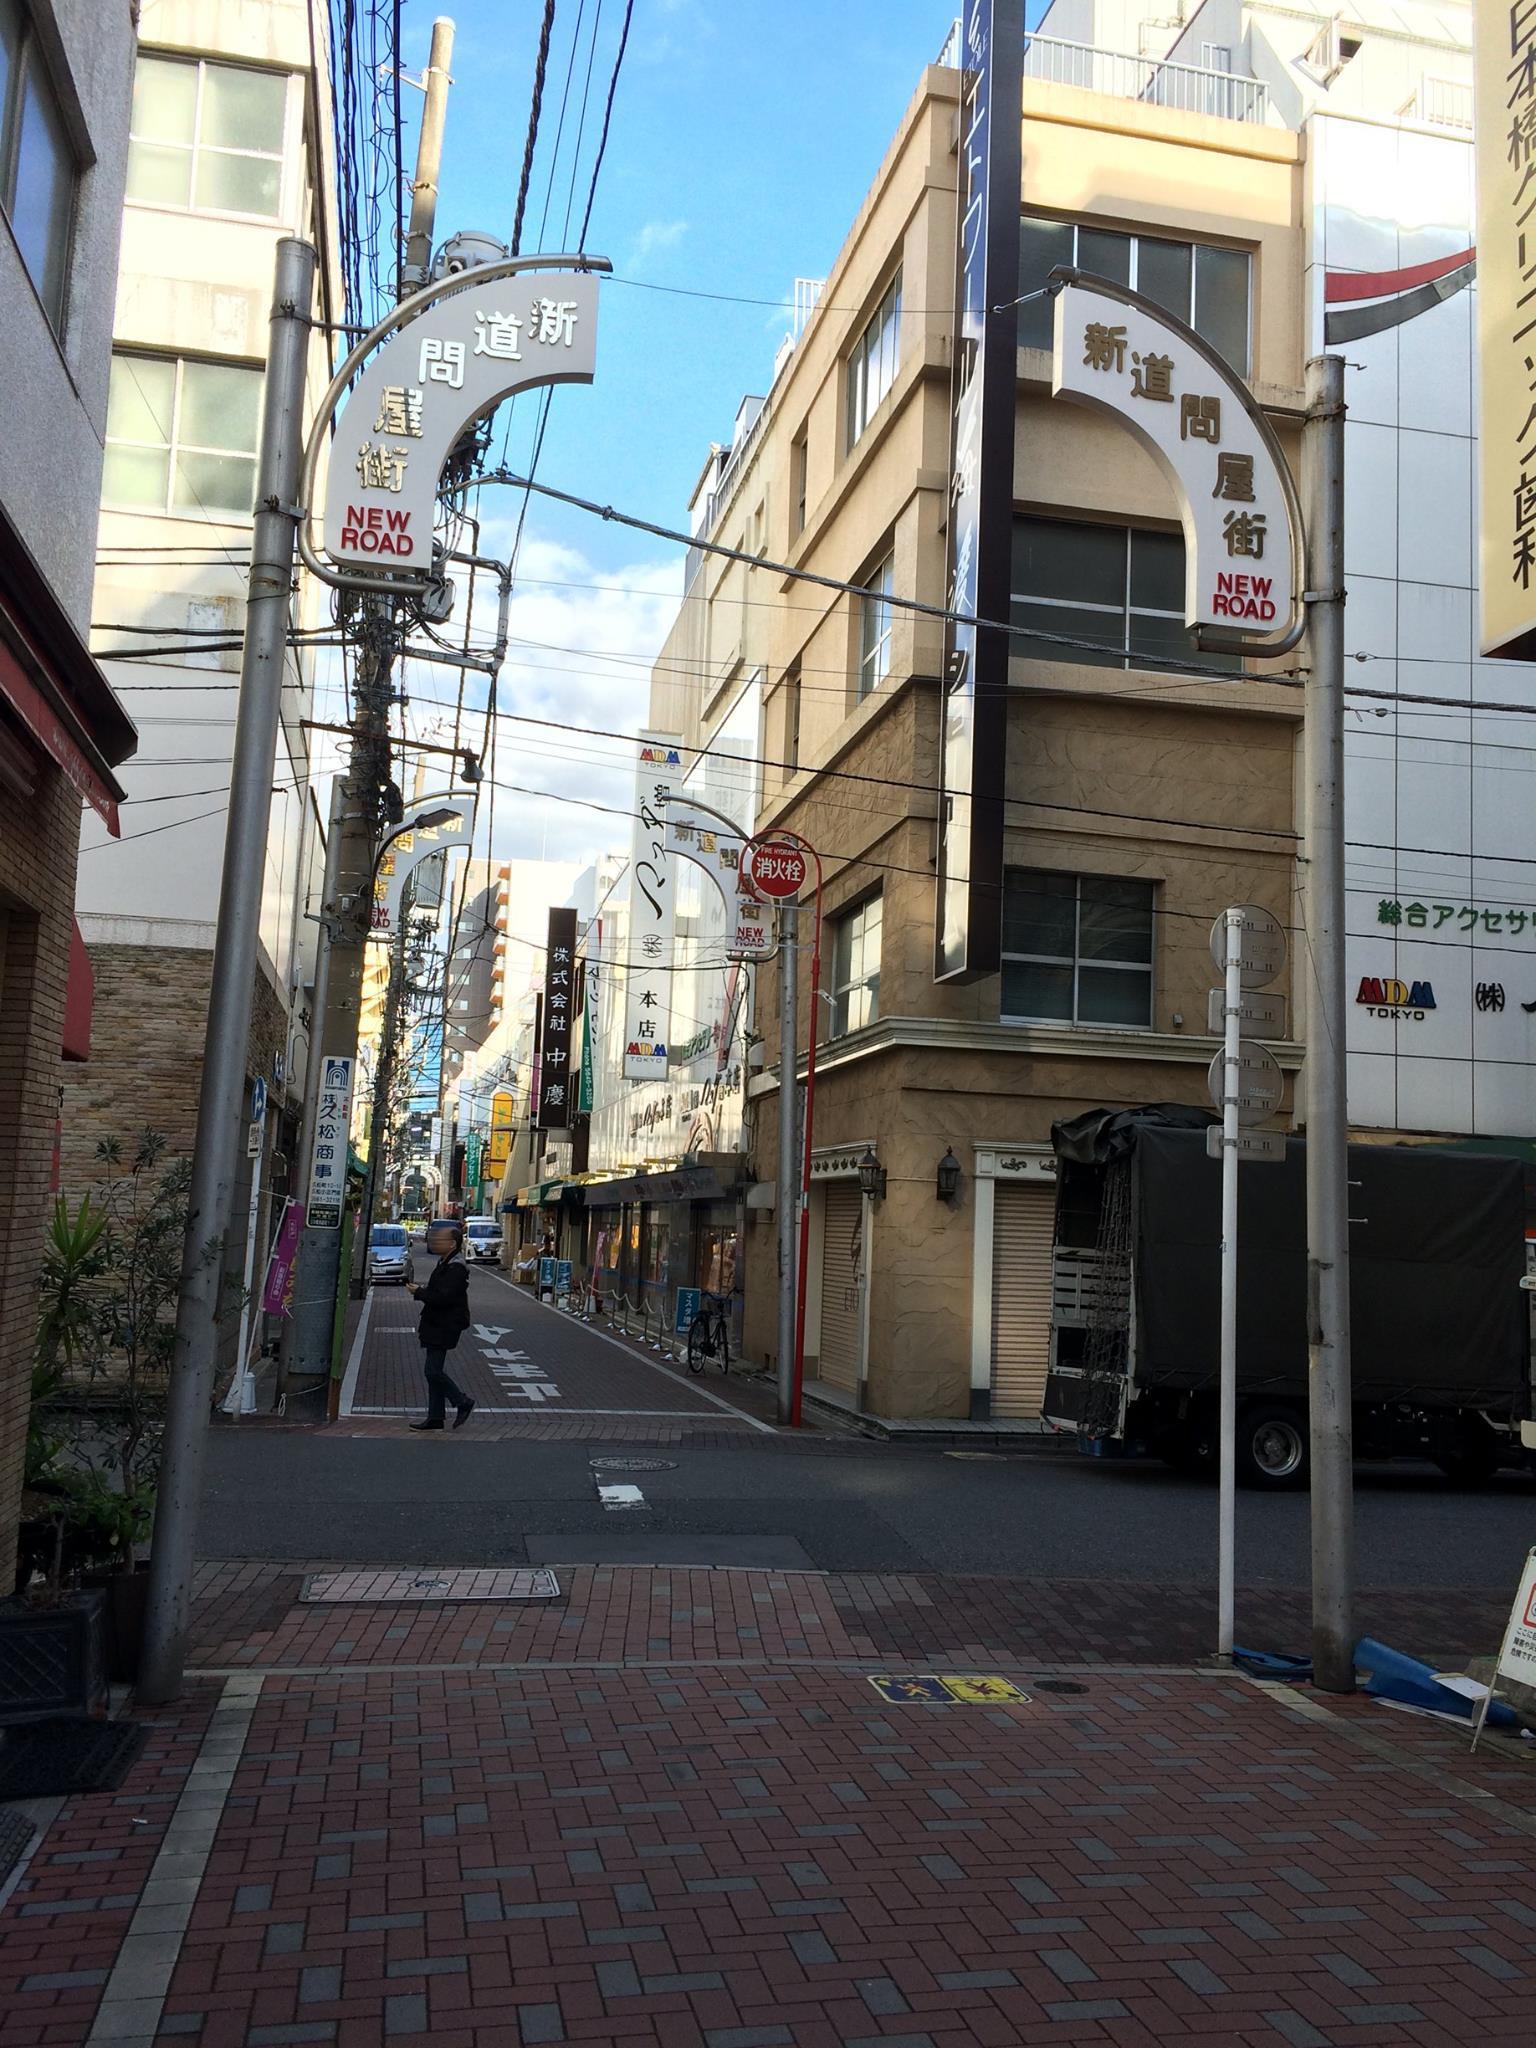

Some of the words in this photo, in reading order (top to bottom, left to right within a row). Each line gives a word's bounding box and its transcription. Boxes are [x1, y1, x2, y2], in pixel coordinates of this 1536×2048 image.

[357, 297, 578, 492] 新道問屋街
[1083, 322, 1267, 560] 新道問屋街
[347, 505, 411, 532] NEW
[341, 527, 414, 556] ROAD
[1217, 572, 1273, 597] NEW
[1212, 593, 1276, 621] ROAD
[645, 762, 676, 770] TOKYO
[761, 846, 773, 855] FIRE
[774, 848, 798, 857] HYDRANT
[756, 856, 802, 882] 消火栓
[1377, 898, 1536, 935] 総合アクセサ
[735, 937, 765, 948] ROAD
[737, 926, 764, 937] NEW
[637, 989, 658, 1038] 本店
[1366, 1007, 1425, 1021] TOKYO
[631, 1056, 662, 1064] TOKYO
